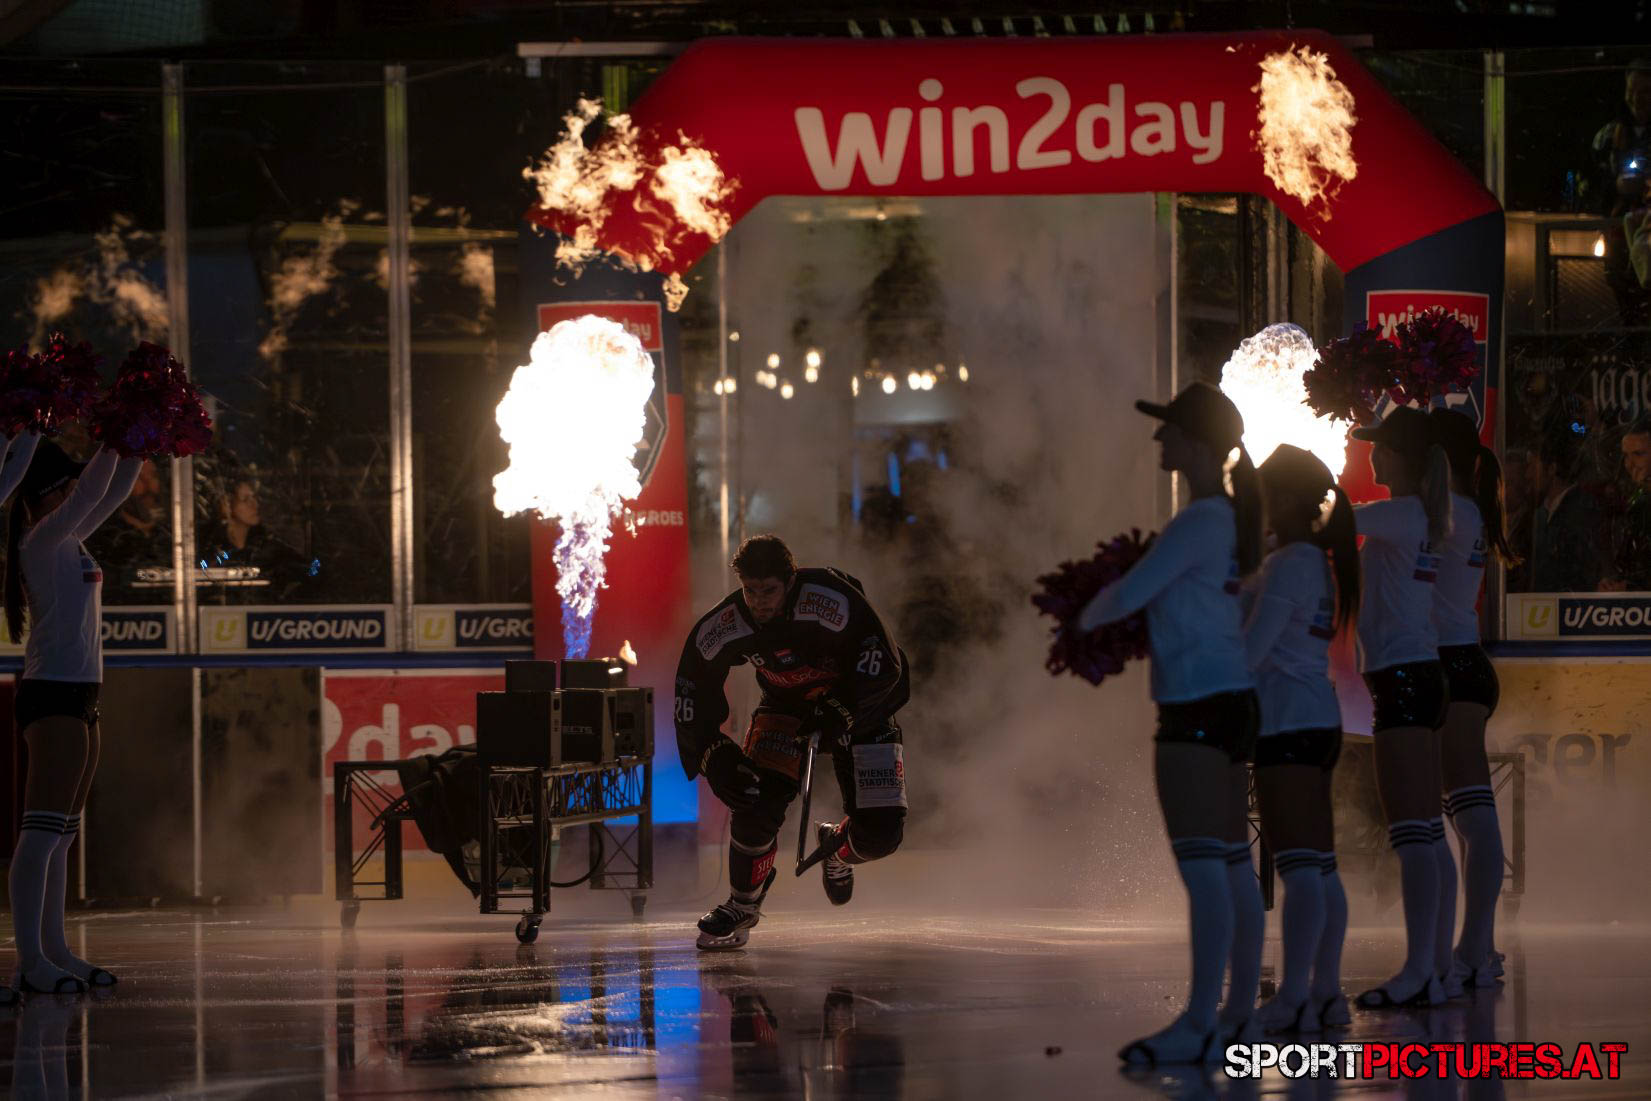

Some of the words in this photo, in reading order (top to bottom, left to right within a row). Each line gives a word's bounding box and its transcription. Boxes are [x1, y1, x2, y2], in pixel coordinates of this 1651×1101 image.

[794, 76, 1225, 191] win2day
[808, 592, 840, 610] WIEN
[800, 603, 845, 626] ENERGIE
[251, 618, 382, 642] U/GROUND
[856, 649, 882, 676] 26
[858, 768, 895, 777] WIENER
